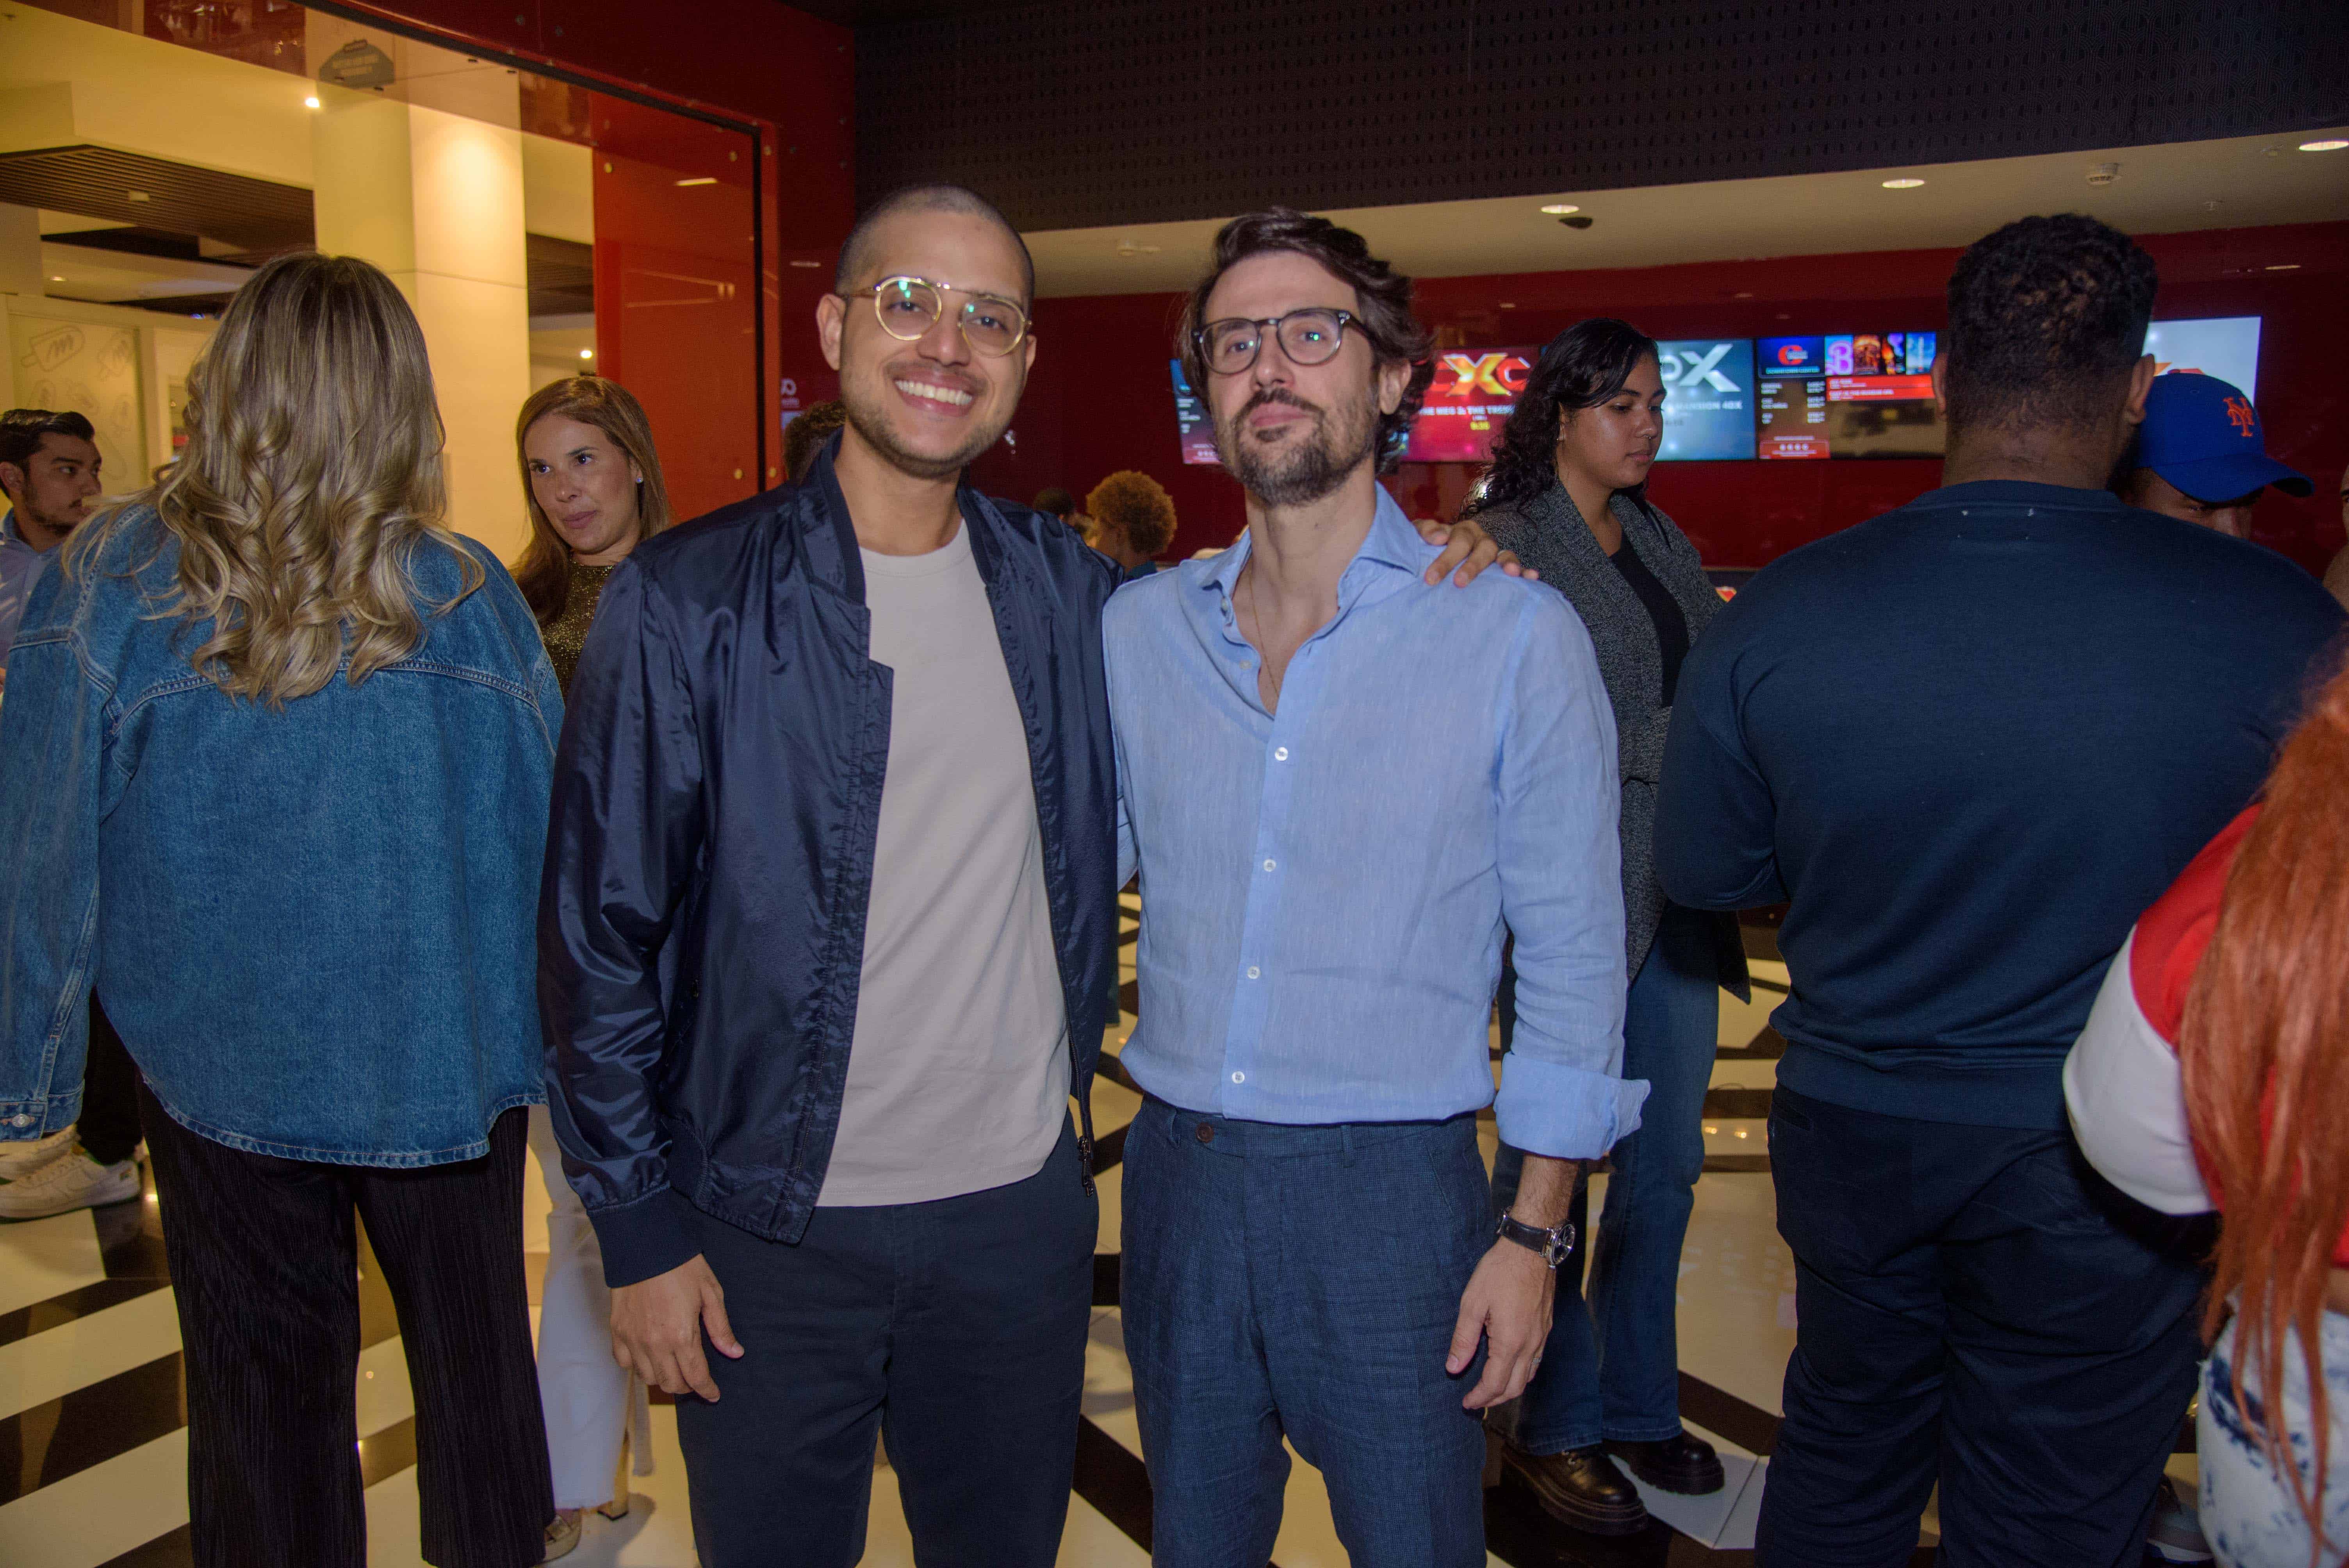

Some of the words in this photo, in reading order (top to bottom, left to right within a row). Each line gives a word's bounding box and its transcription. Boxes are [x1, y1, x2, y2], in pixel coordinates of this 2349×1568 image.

[1660, 344, 1741, 392] DX
[1467, 406, 1485, 415] THE
[2222, 397, 2254, 437] NY
